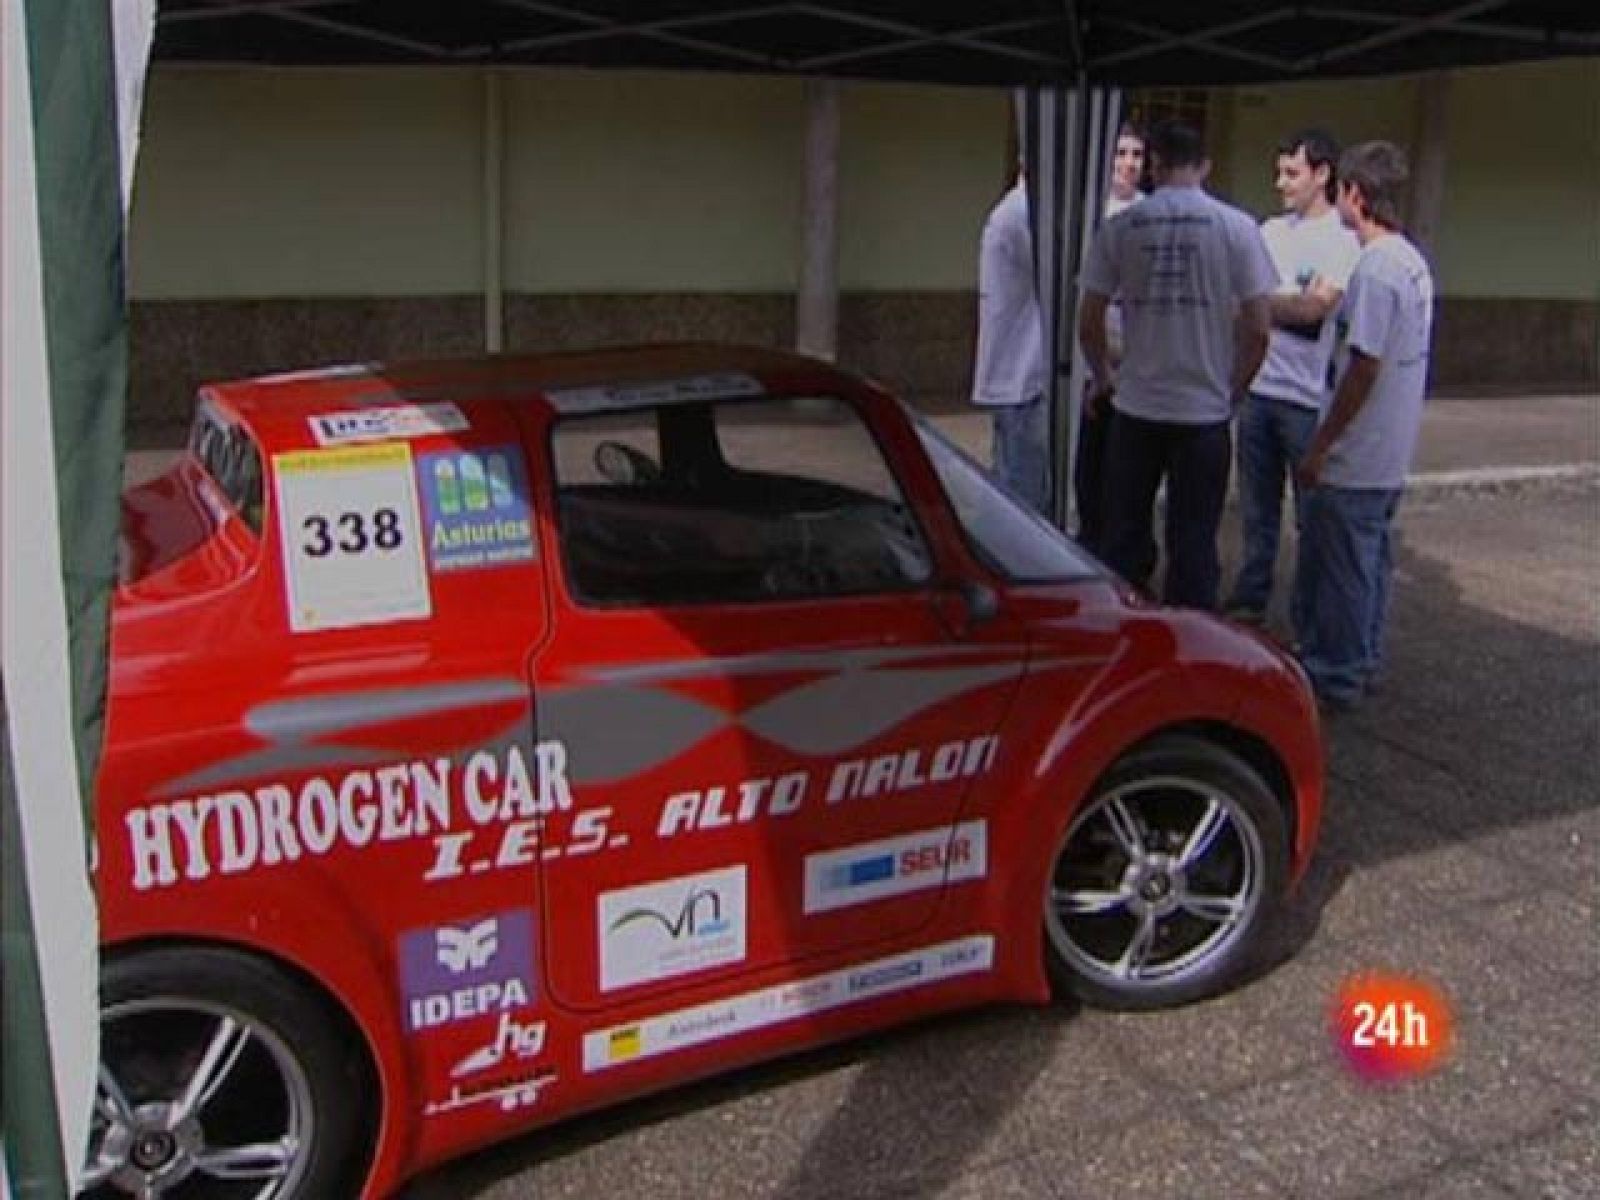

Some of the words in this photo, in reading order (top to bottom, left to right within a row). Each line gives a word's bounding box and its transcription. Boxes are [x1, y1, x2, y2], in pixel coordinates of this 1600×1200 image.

[302, 507, 404, 558] 338
[432, 519, 531, 549] Asturias
[125, 757, 451, 891] HYDROGEN
[463, 739, 573, 825] CAR
[422, 805, 630, 881] I.E.S.
[656, 770, 810, 838] ALTO
[901, 838, 971, 876] SEUR
[410, 978, 529, 1031] IDEPA
